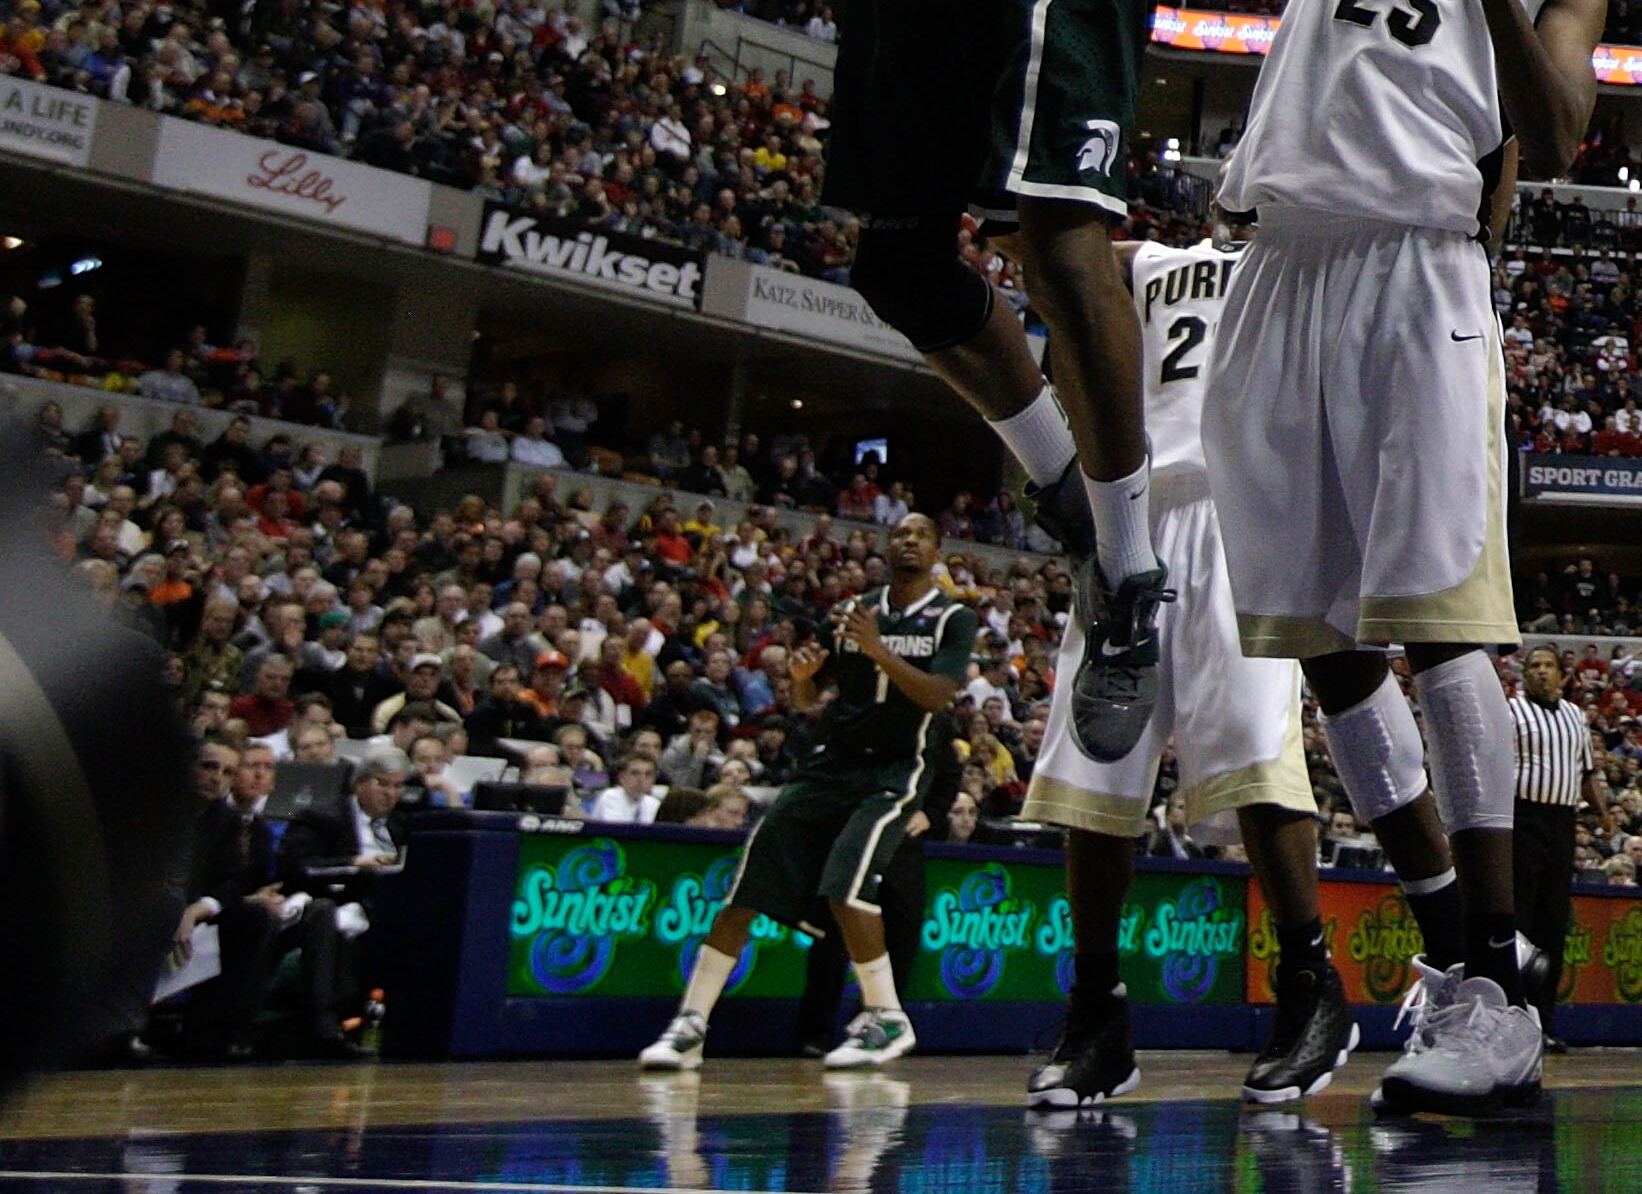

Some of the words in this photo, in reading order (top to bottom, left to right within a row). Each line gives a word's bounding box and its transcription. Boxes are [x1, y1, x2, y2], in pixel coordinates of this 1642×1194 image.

[31, 94, 89, 127] LIFE
[246, 148, 346, 213] Lilly
[482, 211, 700, 300] Kwikset
[801, 287, 858, 323] SAPPER
[1529, 465, 1602, 486] SPORT
[511, 868, 645, 936] Sunkist
[923, 893, 1029, 952] Sunkist
[1146, 902, 1239, 956] Sunkist
